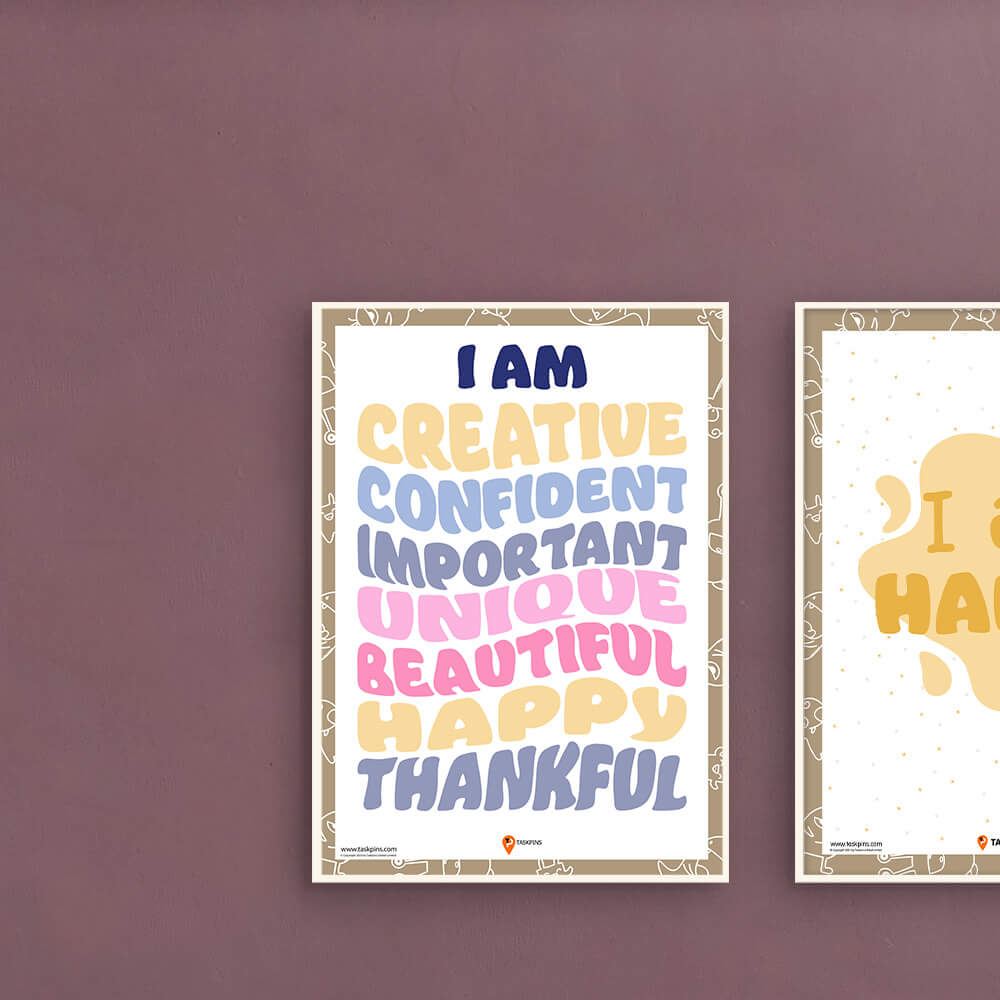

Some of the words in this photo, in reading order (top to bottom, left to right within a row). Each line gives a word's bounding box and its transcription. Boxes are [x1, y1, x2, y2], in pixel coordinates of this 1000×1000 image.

[457, 344, 476, 389] I
[491, 344, 588, 390] AM
[357, 402, 687, 472] CREATIVE
[357, 465, 687, 534] CONFIDENT
[922, 490, 955, 554] I
[357, 520, 687, 590] IMPORTANT
[357, 568, 687, 642] UNIQUE
[357, 622, 687, 697] BEAUTIFUL
[357, 677, 687, 752] HAPPY
[357, 741, 687, 811] THANKFUL
[829, 840, 883, 848] www.taskpins.com
